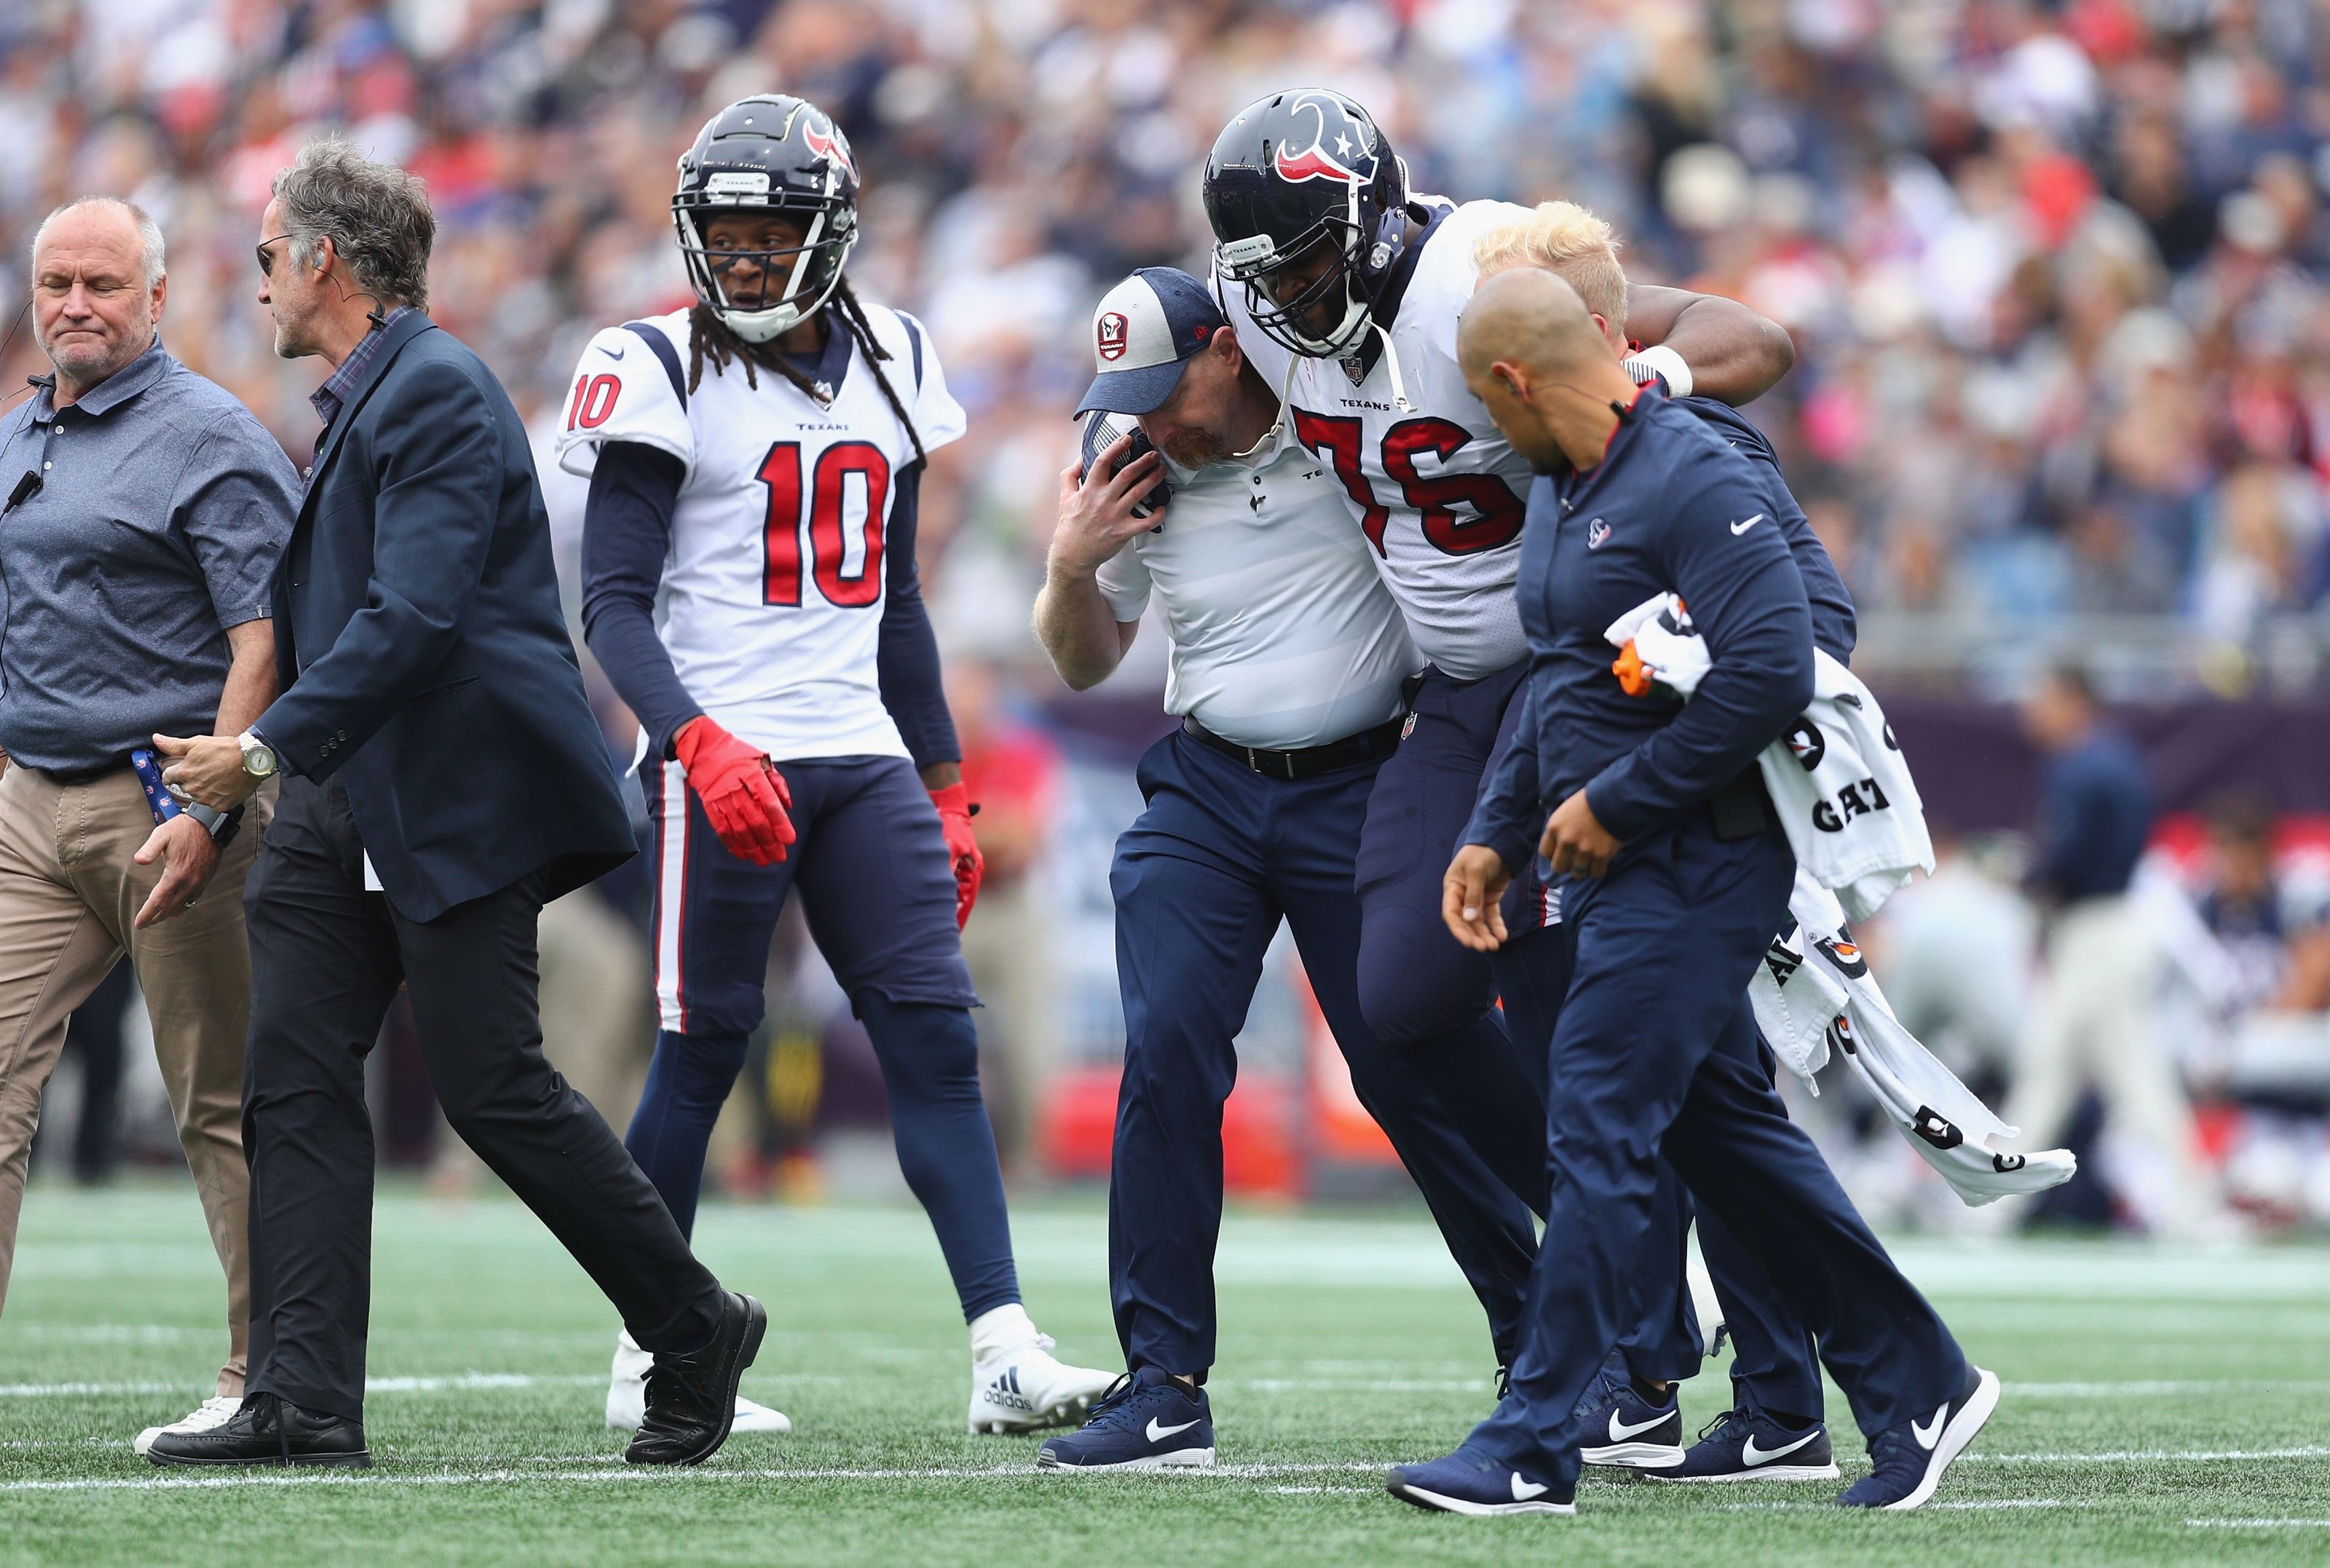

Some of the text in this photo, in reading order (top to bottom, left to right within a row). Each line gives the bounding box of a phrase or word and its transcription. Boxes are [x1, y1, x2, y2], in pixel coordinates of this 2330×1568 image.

[1347, 367, 1362, 379] NFL
[567, 374, 622, 431] 10
[1340, 398, 1390, 411] TEXANS
[795, 423, 850, 431] TEXANS
[1290, 405, 1526, 559] 76
[754, 440, 890, 609] 10
[984, 1389, 1032, 1410] adidas
